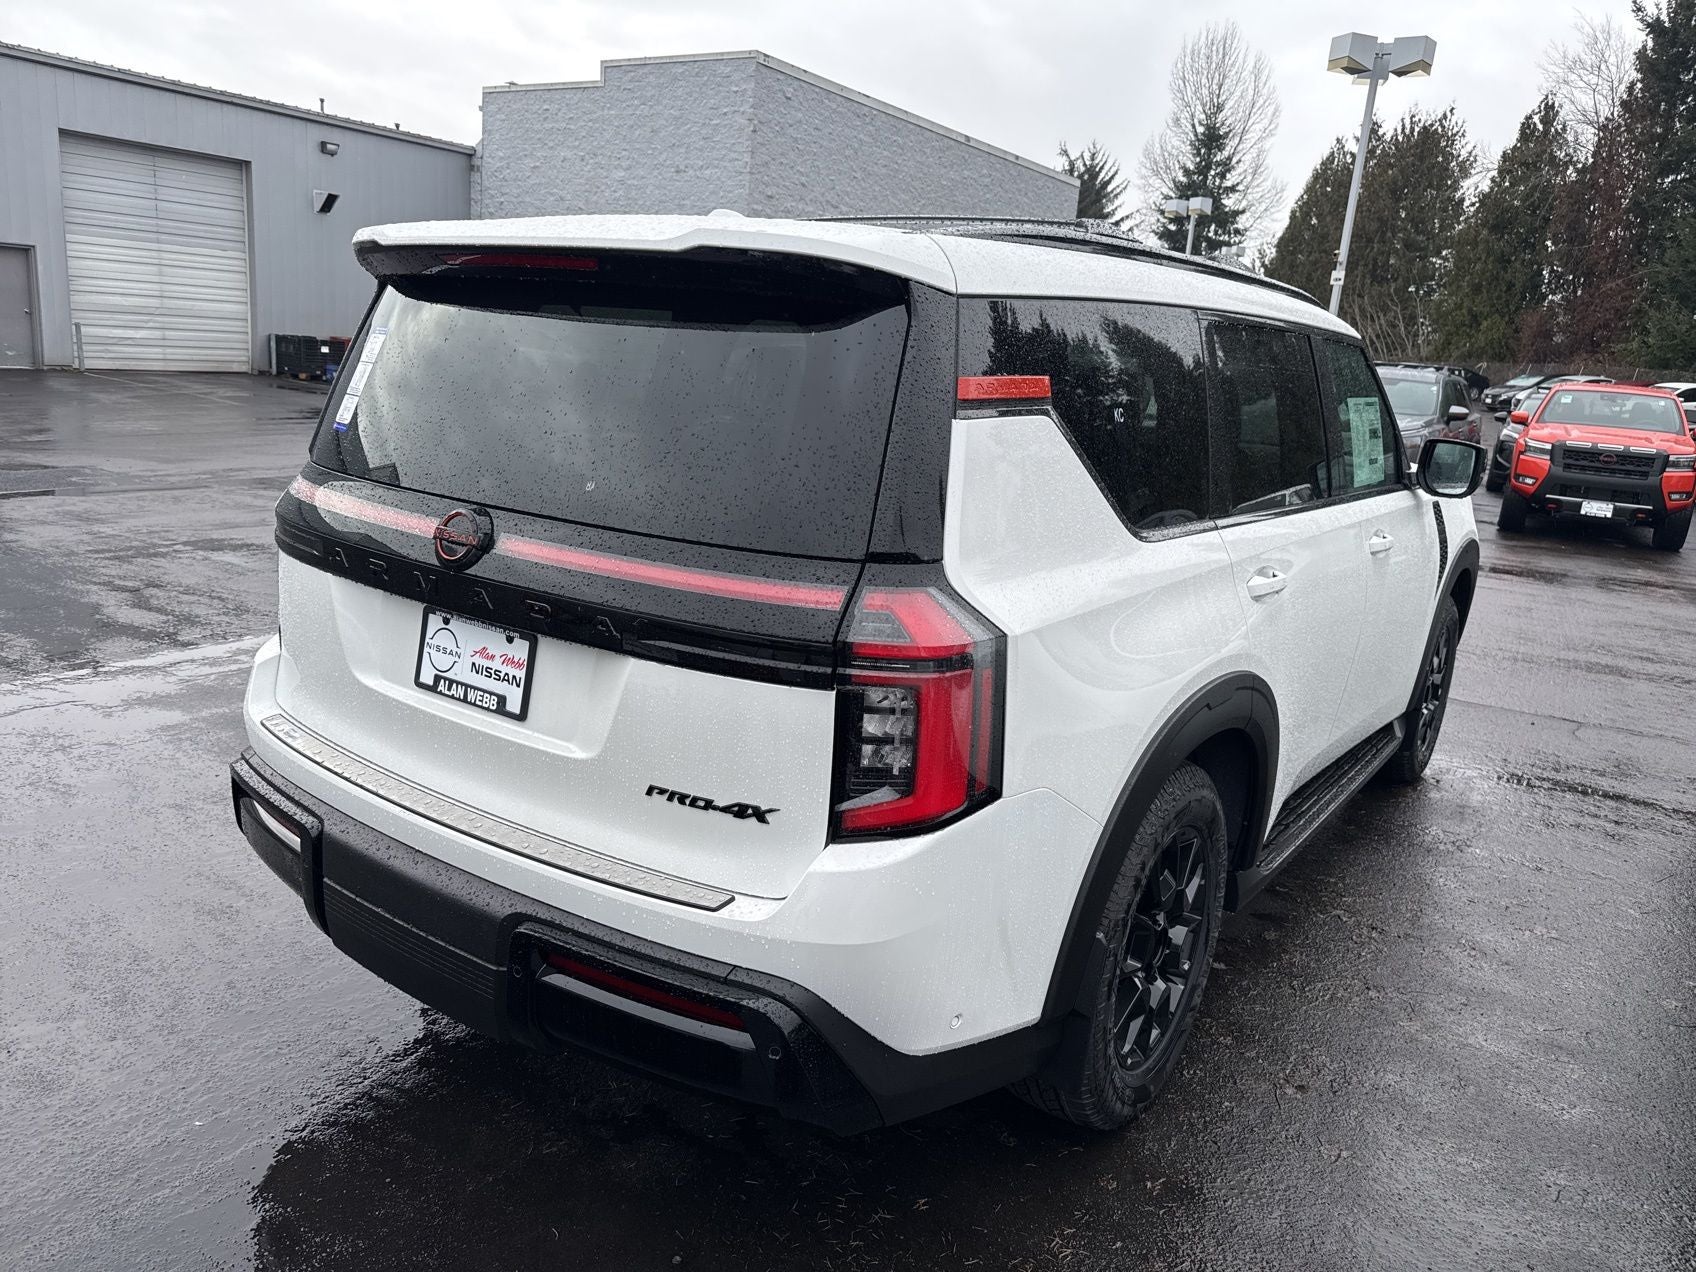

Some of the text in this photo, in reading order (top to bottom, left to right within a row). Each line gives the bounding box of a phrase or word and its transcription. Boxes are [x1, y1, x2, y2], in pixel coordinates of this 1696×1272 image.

[434, 526, 478, 546] NISSAN
[329, 547, 622, 639] ARMADA
[435, 610, 520, 638] www.alanwebbnissan.com
[425, 641, 461, 659] NISSAN
[470, 646, 526, 671] Alan Webb
[470, 661, 522, 688] NISSAN
[437, 679, 498, 710] ALAN WEBB
[644, 783, 781, 825] PRO-4X
